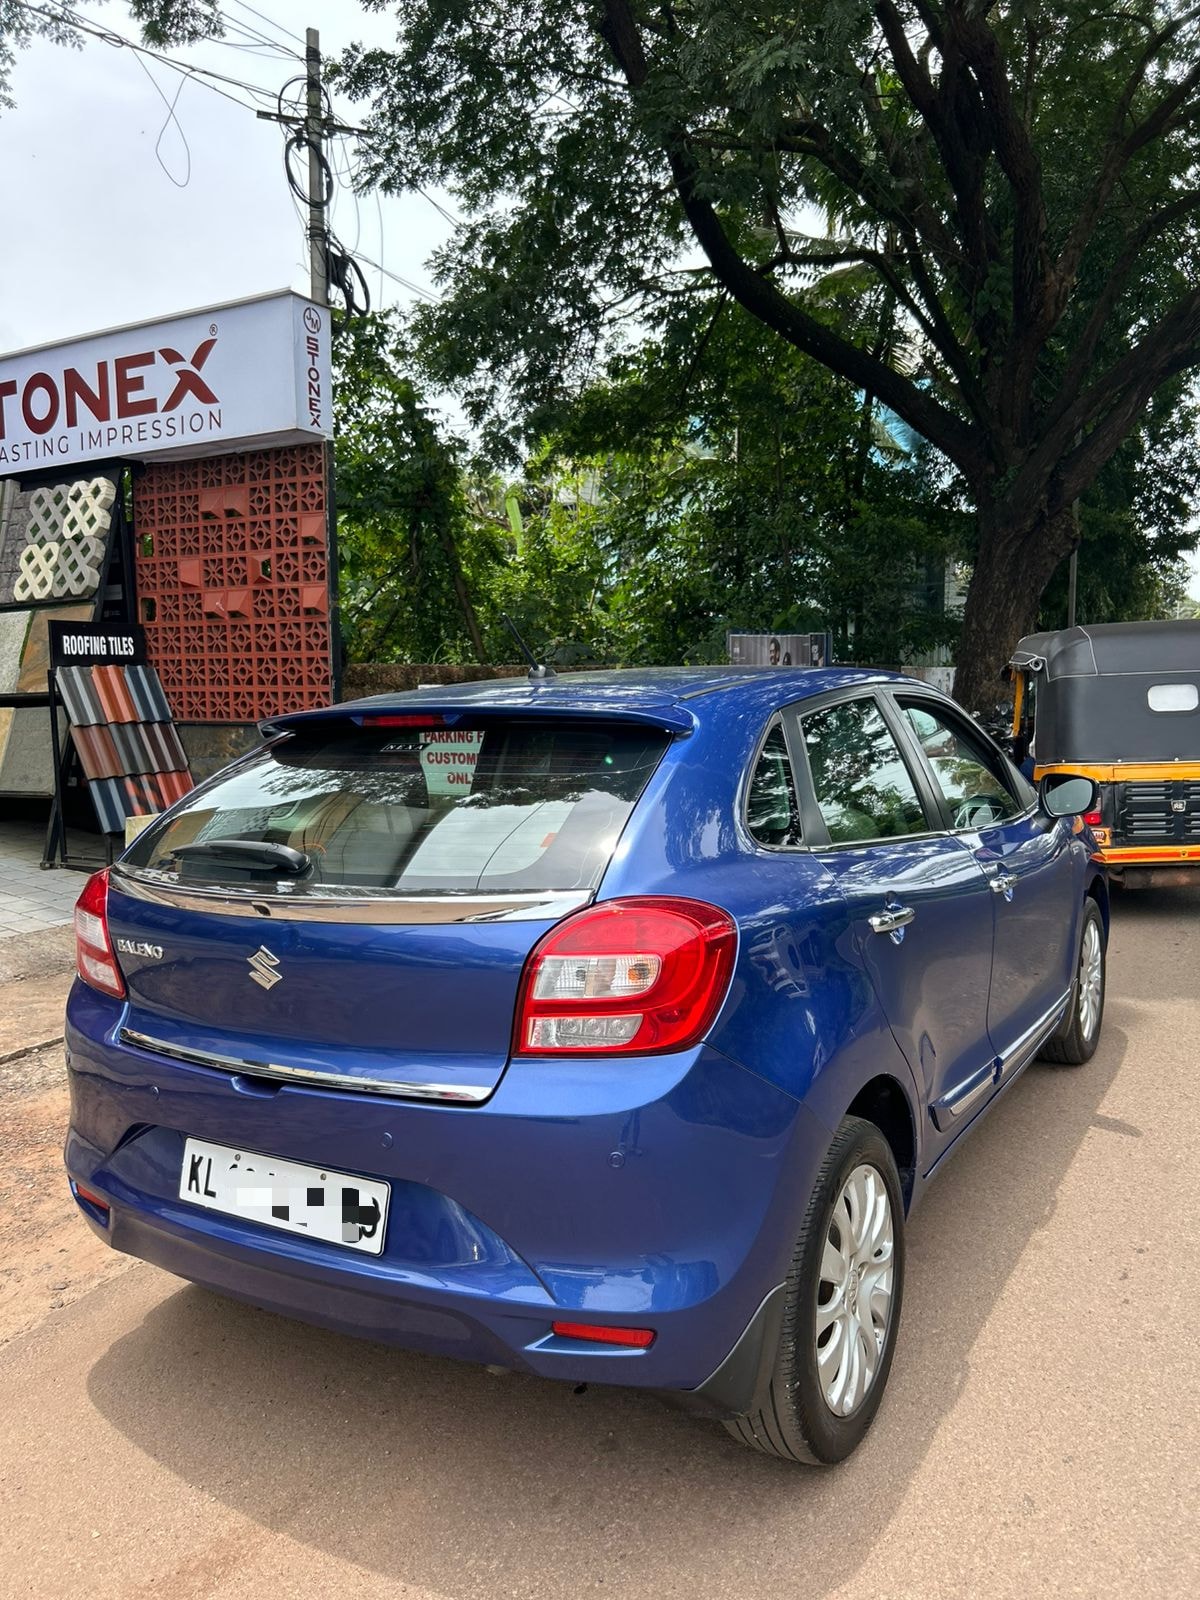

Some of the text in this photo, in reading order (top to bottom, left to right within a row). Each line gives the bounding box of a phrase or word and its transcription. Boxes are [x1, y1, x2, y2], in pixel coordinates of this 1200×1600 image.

[307, 335, 321, 428] STONEX
[0, 408, 222, 463] ASTING IMPRESSION
[62, 635, 135, 656] ROOFING TILES
[424, 731, 474, 743] PARKING
[117, 939, 163, 959] BALENO
